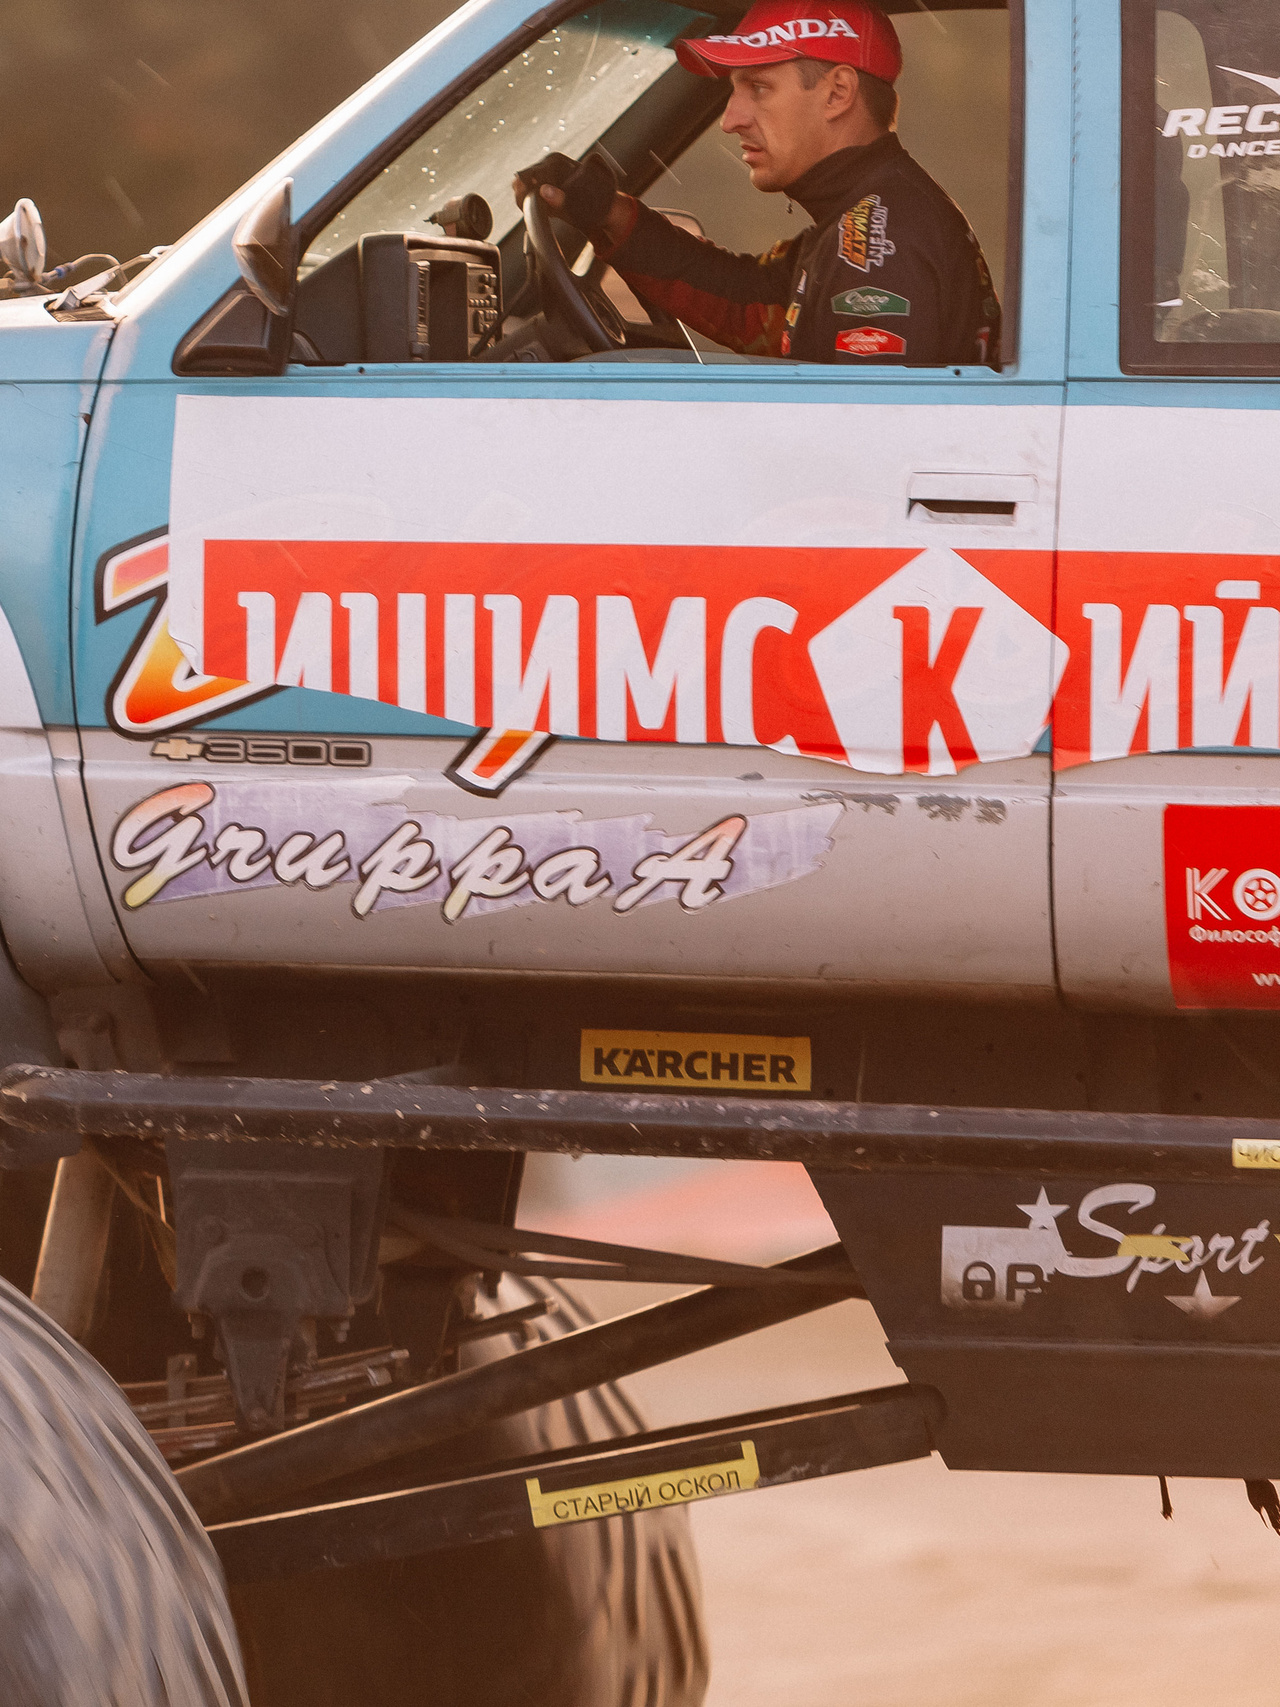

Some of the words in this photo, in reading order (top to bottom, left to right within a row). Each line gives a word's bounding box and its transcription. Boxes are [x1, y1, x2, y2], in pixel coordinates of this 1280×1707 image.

[706, 18, 859, 47] HONDA
[205, 738, 372, 767] 3500
[611, 814, 748, 915] A
[593, 1047, 798, 1084] KÄRCHER
[553, 1482, 652, 1520] СТАРЫЙ
[658, 1469, 741, 1500] ОСКОЛ
